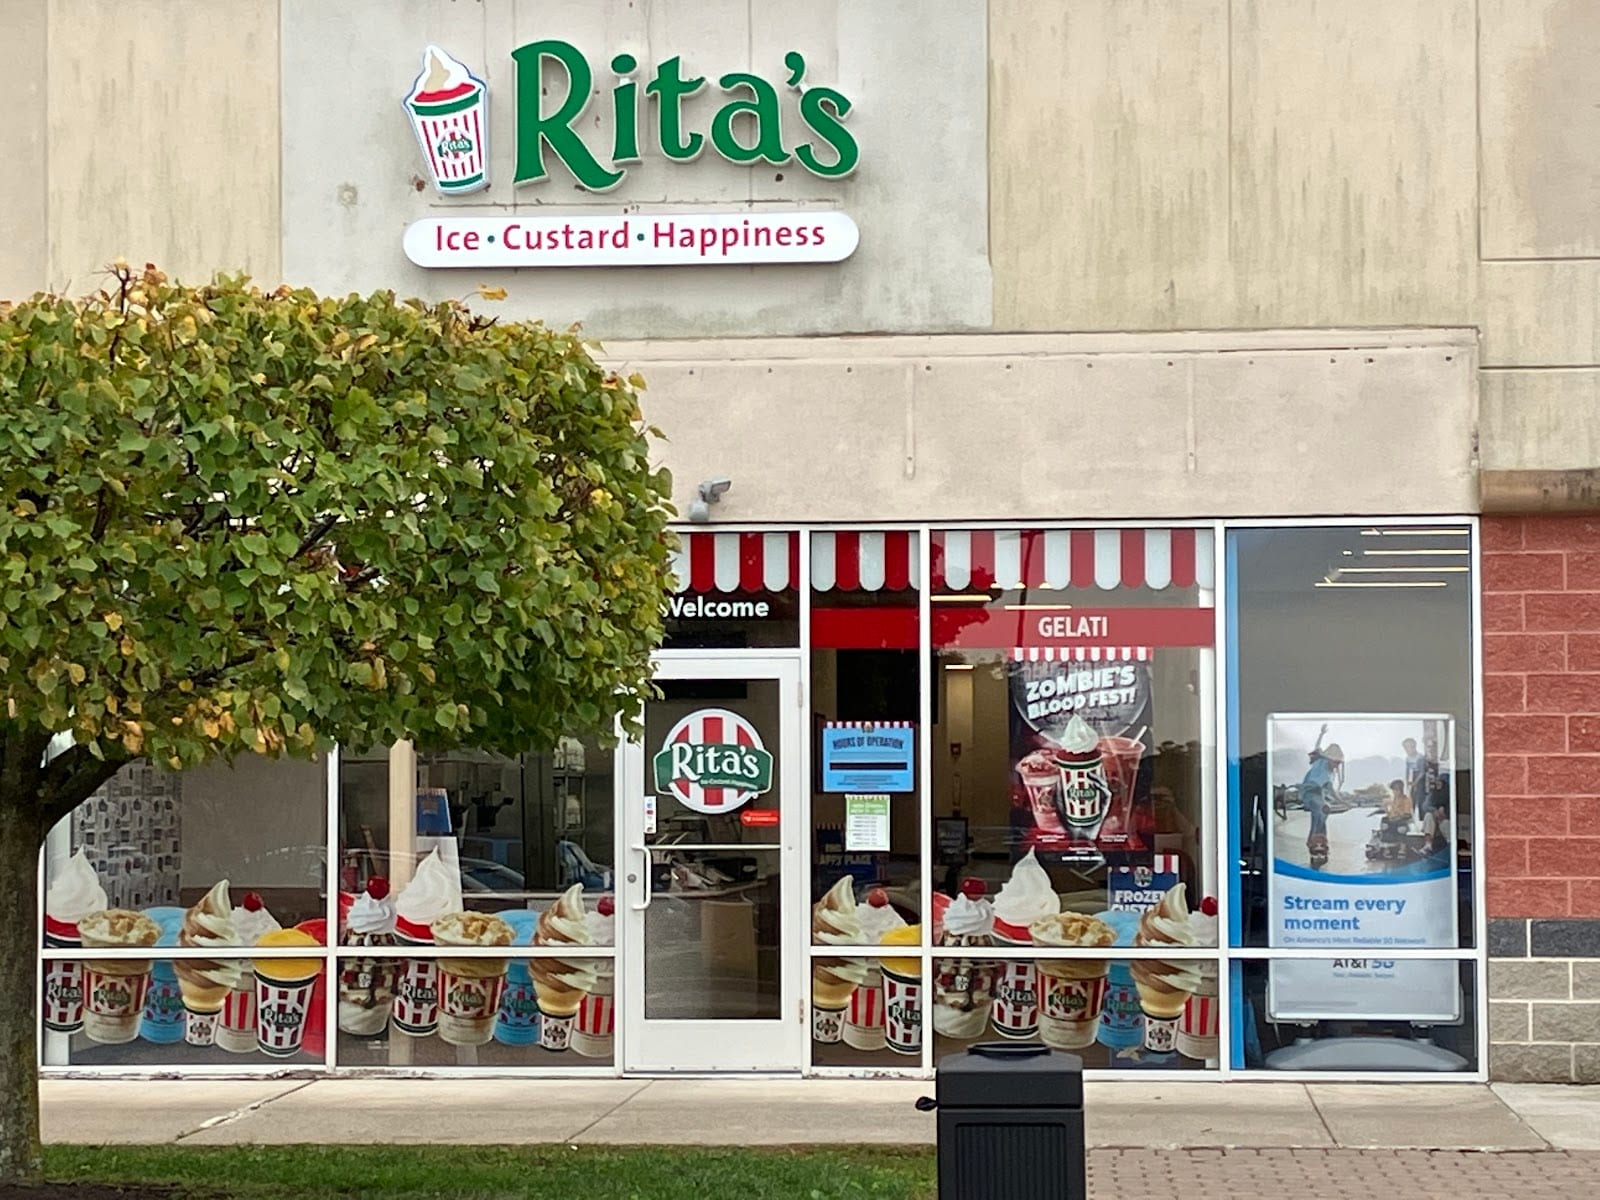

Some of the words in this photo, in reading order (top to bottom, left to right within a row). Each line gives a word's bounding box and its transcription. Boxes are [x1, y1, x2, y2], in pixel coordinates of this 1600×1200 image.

[512, 39, 858, 192] Rita's
[436, 225, 480, 251] Ice
[503, 221, 630, 250] Custard
[653, 220, 826, 256] Happiness
[1038, 616, 1109, 637] GELATI
[1025, 665, 1137, 702] ZOMBIE'S
[1027, 694, 1086, 720] BLOOD
[1089, 687, 1136, 708] FEST!
[671, 742, 760, 781] Rita's
[1115, 890, 1166, 903] FROZE
[1283, 895, 1349, 910] Stream
[1354, 899, 1406, 915] every
[1284, 916, 1360, 930] moment
